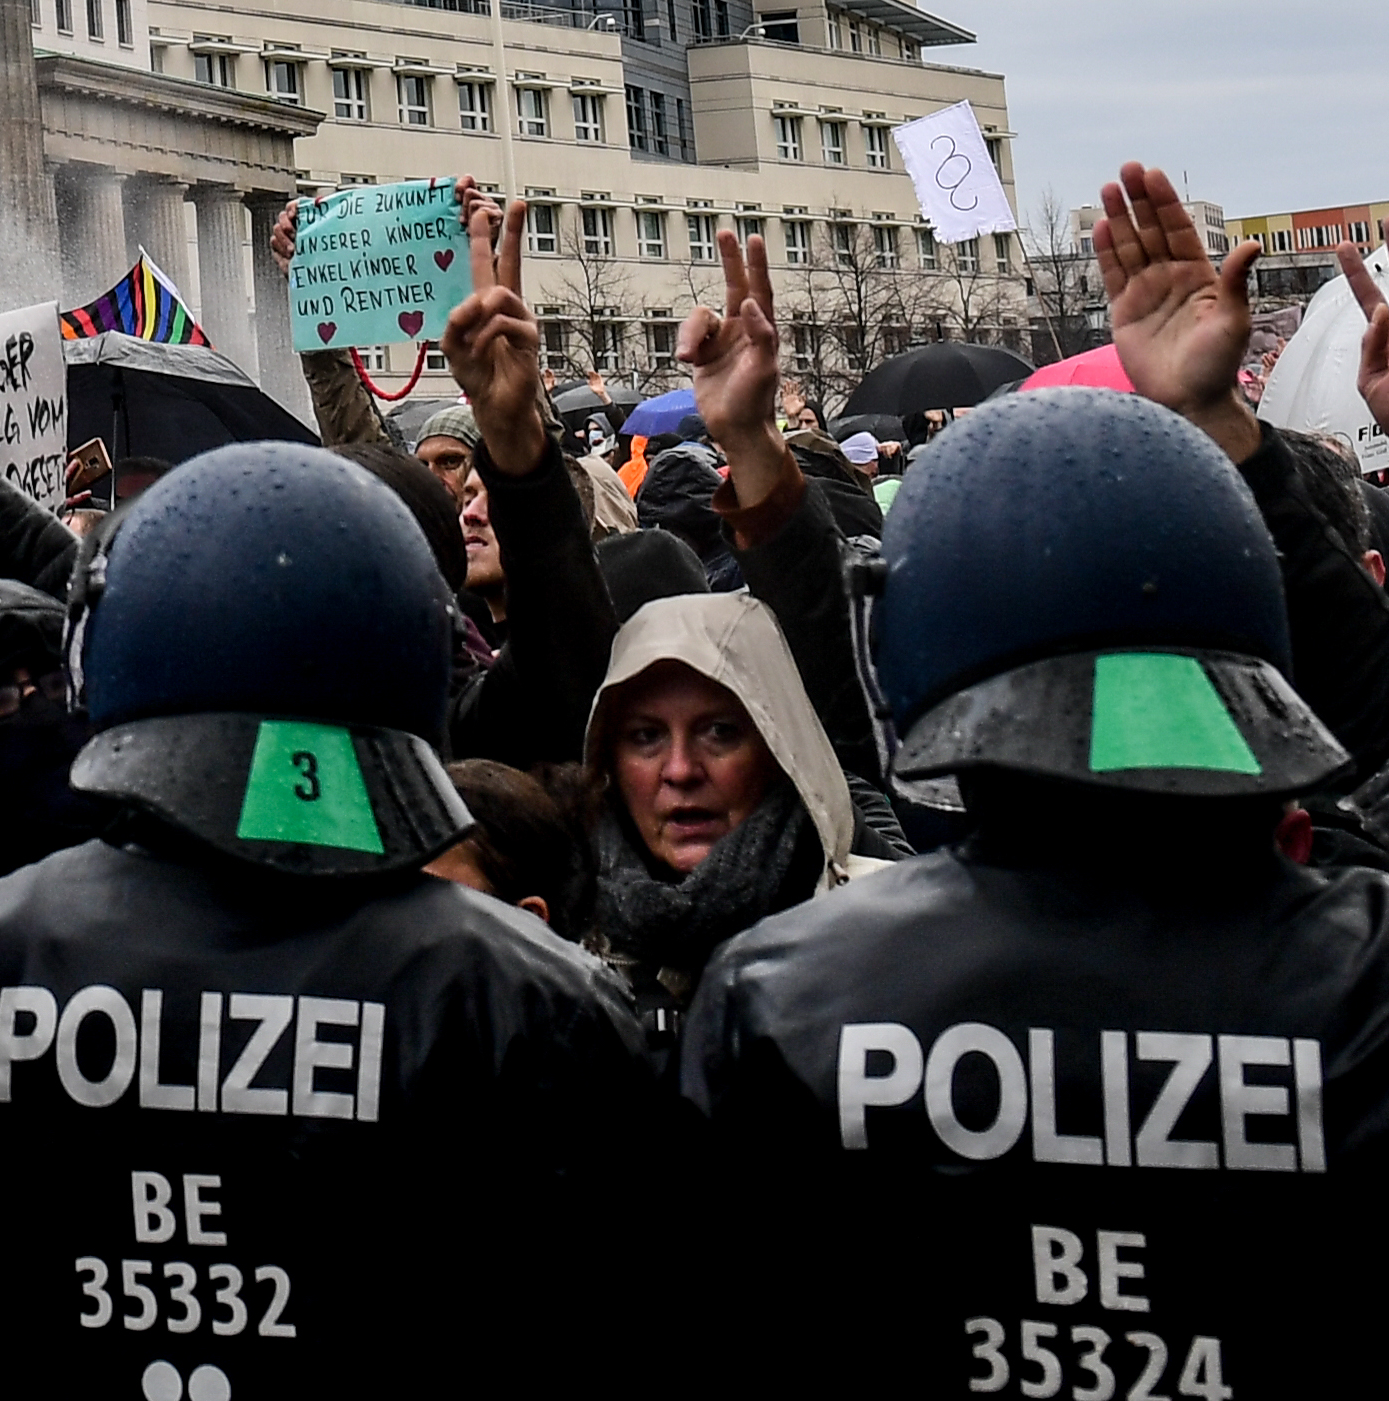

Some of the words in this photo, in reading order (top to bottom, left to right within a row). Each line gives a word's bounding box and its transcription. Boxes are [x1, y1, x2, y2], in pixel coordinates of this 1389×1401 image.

[376, 184, 451, 212] ZUKUNFT
[296, 229, 372, 255] UNSERER
[298, 296, 333, 316] UND
[341, 282, 436, 312] RENTNER
[27, 396, 65, 439] VOM
[292, 750, 321, 802] 3
[837, 1022, 1326, 1172] POLIZEI
[131, 1171, 227, 1246] BE
[75, 1258, 296, 1338] 35332
[1031, 1225, 1150, 1313] BE
[964, 1317, 1233, 1401] 35324
